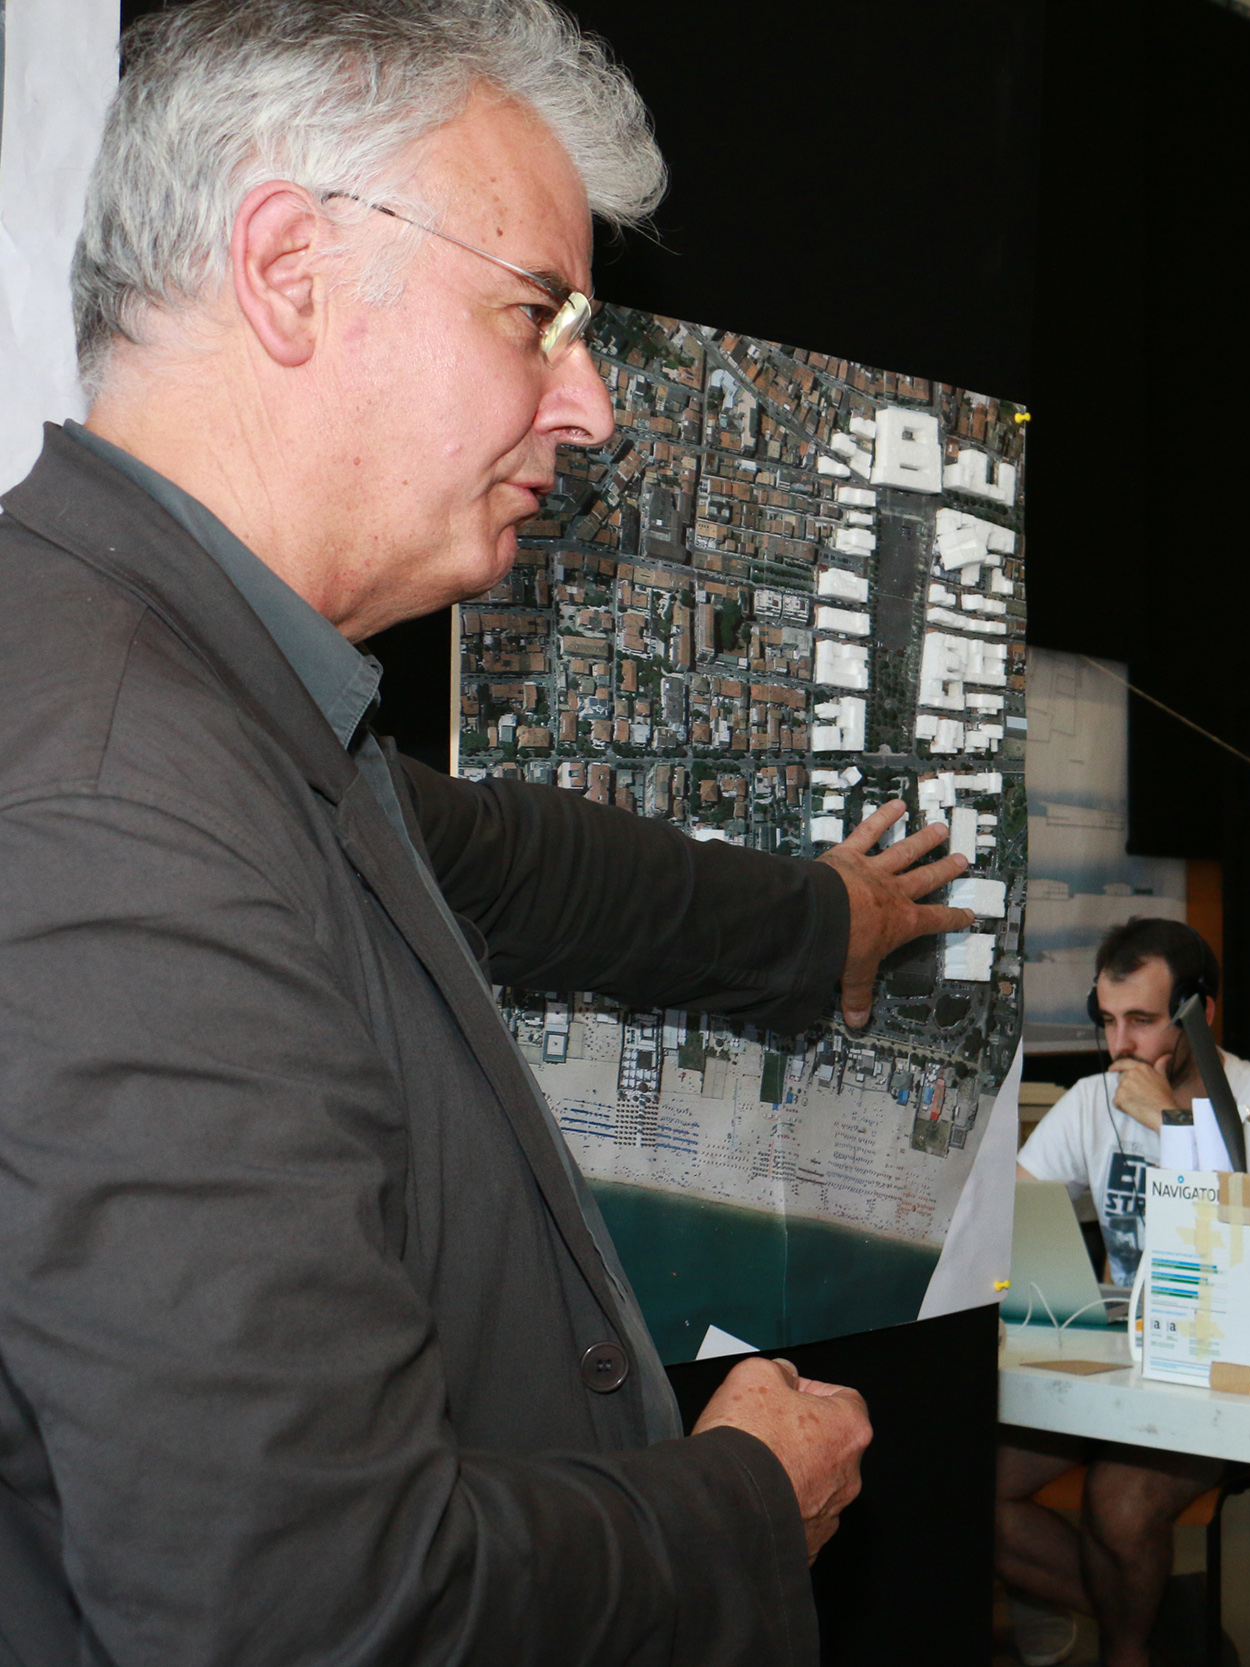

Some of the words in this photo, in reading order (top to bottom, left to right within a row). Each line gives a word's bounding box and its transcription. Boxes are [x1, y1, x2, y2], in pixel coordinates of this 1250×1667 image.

[1152, 1181, 1220, 1203] NAVIGATO
[1153, 1319, 1161, 1330] a
[1169, 1322, 1177, 1332] a
